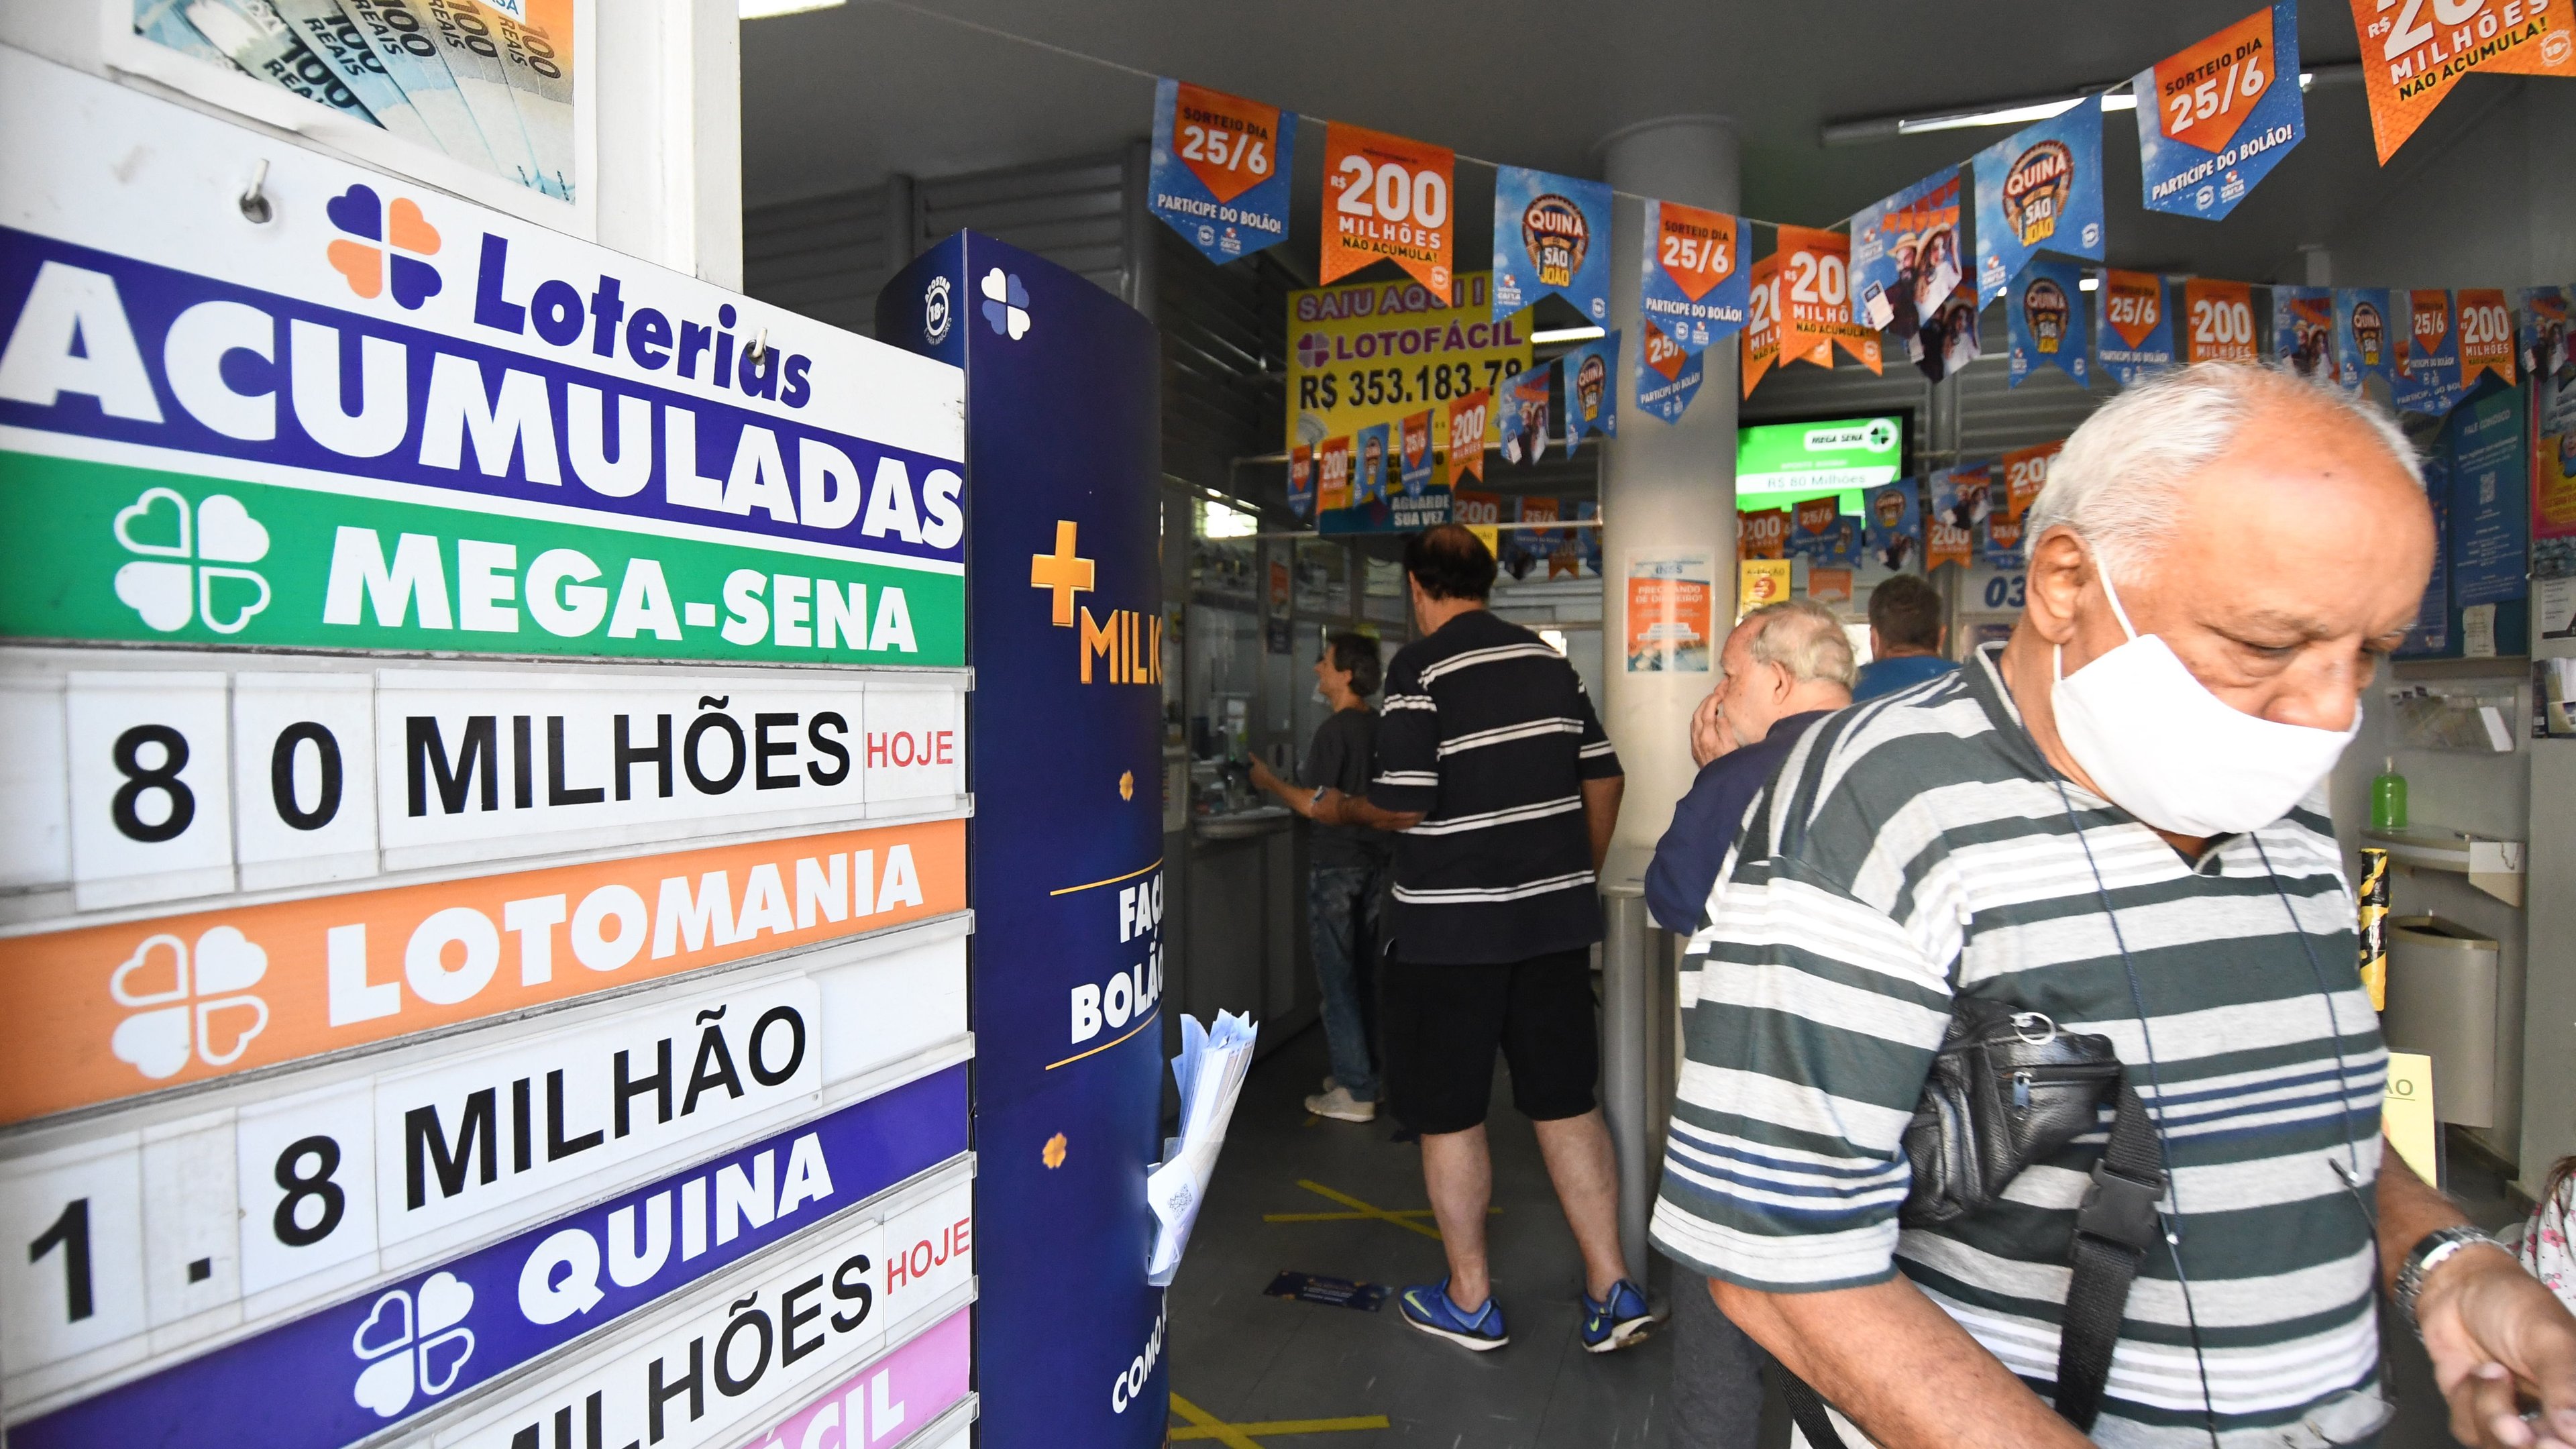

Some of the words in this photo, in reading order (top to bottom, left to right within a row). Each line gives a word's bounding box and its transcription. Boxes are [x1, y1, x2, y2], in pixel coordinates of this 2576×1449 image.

[303, 17, 366, 76] REAIS
[446, 1, 498, 58] 100
[498, 15, 528, 66] REAIS
[2368, 16, 2391, 39] R$
[2166, 53, 2231, 96] SORTEIO
[2236, 38, 2263, 61] DIA
[2400, 72, 2436, 101] NÃO
[2442, 16, 2548, 80] ACUMULA!
[263, 59, 335, 109] REA
[2170, 56, 2265, 135] 25/6
[1184, 107, 1243, 131] SORTEIO
[1247, 123, 1268, 140] DIA
[1182, 125, 1268, 174] 25/6
[2152, 159, 2214, 201] PARTICIPE
[2216, 150, 2237, 171] DO
[2240, 124, 2292, 161] BOLÃO!
[1331, 176, 1346, 189] R$
[1338, 155, 1446, 228] 200
[2006, 152, 2068, 195] QUINA
[1157, 194, 1217, 219] PARTICIPE
[1220, 207, 1238, 223] DO
[1240, 211, 1282, 233] BOLÃO!
[1528, 209, 1584, 237] QUINA
[2025, 197, 2051, 225] SÃO
[1339, 216, 1441, 249] MILHÕES
[1342, 235, 1368, 250] NÃO
[1373, 244, 1438, 262] ACUMULA!
[1665, 221, 1708, 237] SORTEIO
[1711, 229, 1729, 241] DIA
[1544, 246, 1568, 268] SÃO
[1664, 236, 1728, 273] 25/6
[924, 276, 951, 303] APOSTAR
[1297, 288, 1374, 322] SAIU
[473, 233, 812, 409] Loterias
[930, 303, 945, 323] 18+
[1646, 298, 1690, 316] PARTICIPE
[1692, 304, 1706, 317] DO
[1708, 306, 1742, 322] BOLÃO!
[1793, 304, 1849, 323] MILHÕ
[1796, 319, 1817, 333] NÃO
[2110, 297, 2156, 326] 25/6
[2194, 299, 2252, 344] 200
[2415, 312, 2445, 335] 25/6
[2463, 305, 2509, 344] 200
[1337, 317, 1523, 360] LOTOFÁCIL
[2466, 341, 2510, 357] MILHÕES
[0, 260, 964, 551] ACUMULADAS
[1300, 373, 1338, 413] R$
[1453, 405, 1486, 449] 200
[1812, 435, 1837, 444] MEGA
[1841, 434, 1864, 443] SENA
[1768, 477, 1785, 489] R$
[1790, 476, 1807, 487] 80
[1811, 474, 1866, 486] Milhões
[1454, 500, 1498, 523] 200
[323, 525, 918, 653] MEGA-SENA
[1636, 595, 1648, 603] DE
[1639, 586, 1701, 595] PRECANDO
[1985, 576, 2025, 608] 03
[406, 696, 851, 818] MILHÕES
[865, 730, 955, 769] HOJE
[326, 844, 924, 1028] LOTOMANIA
[405, 1004, 807, 1212] MILHÃO
[518, 1133, 833, 1326] QUINA
[506, 1254, 873, 1449] ILHÕES
[888, 1218, 971, 1296] HOJE
[1112, 1316, 1161, 1413] COMO
